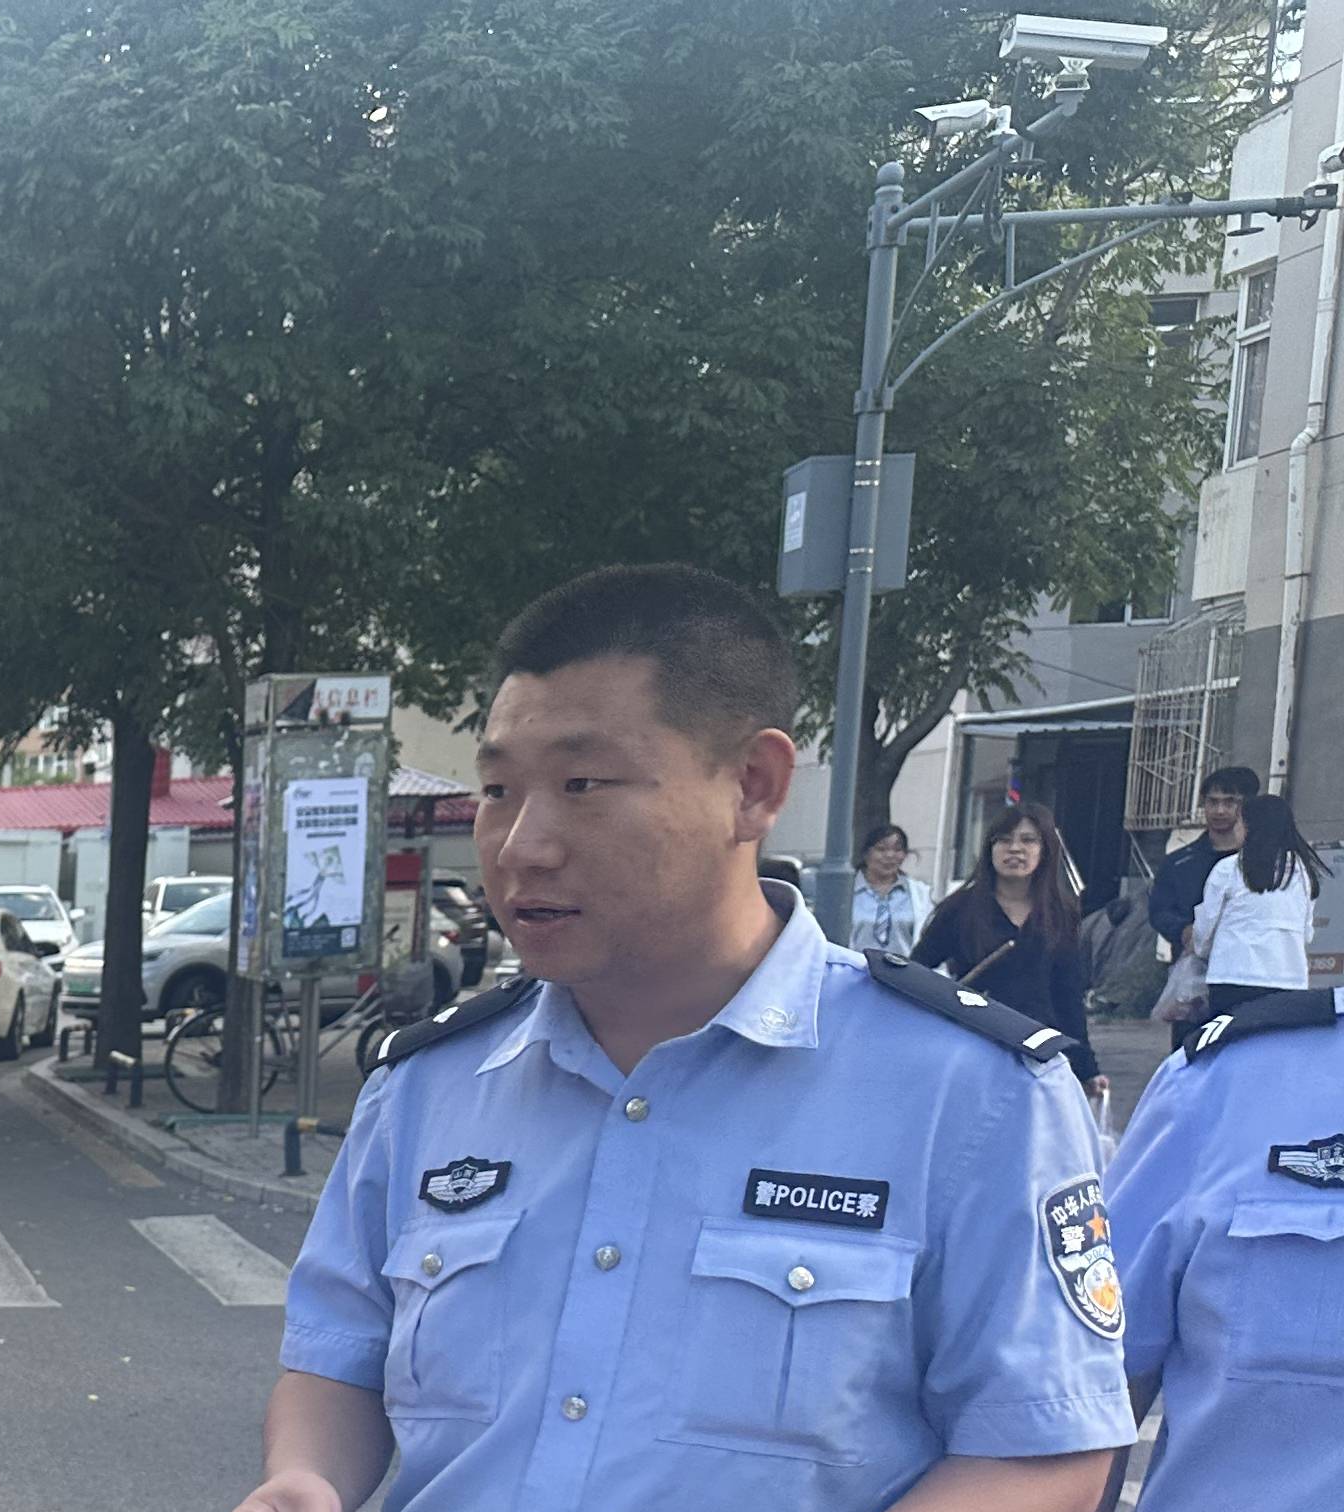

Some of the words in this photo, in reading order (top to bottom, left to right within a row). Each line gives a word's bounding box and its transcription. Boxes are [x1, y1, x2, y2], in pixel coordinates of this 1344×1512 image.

[755, 1180, 880, 1218] 警POLICE察
[1051, 1184, 1105, 1226] 中华人民
